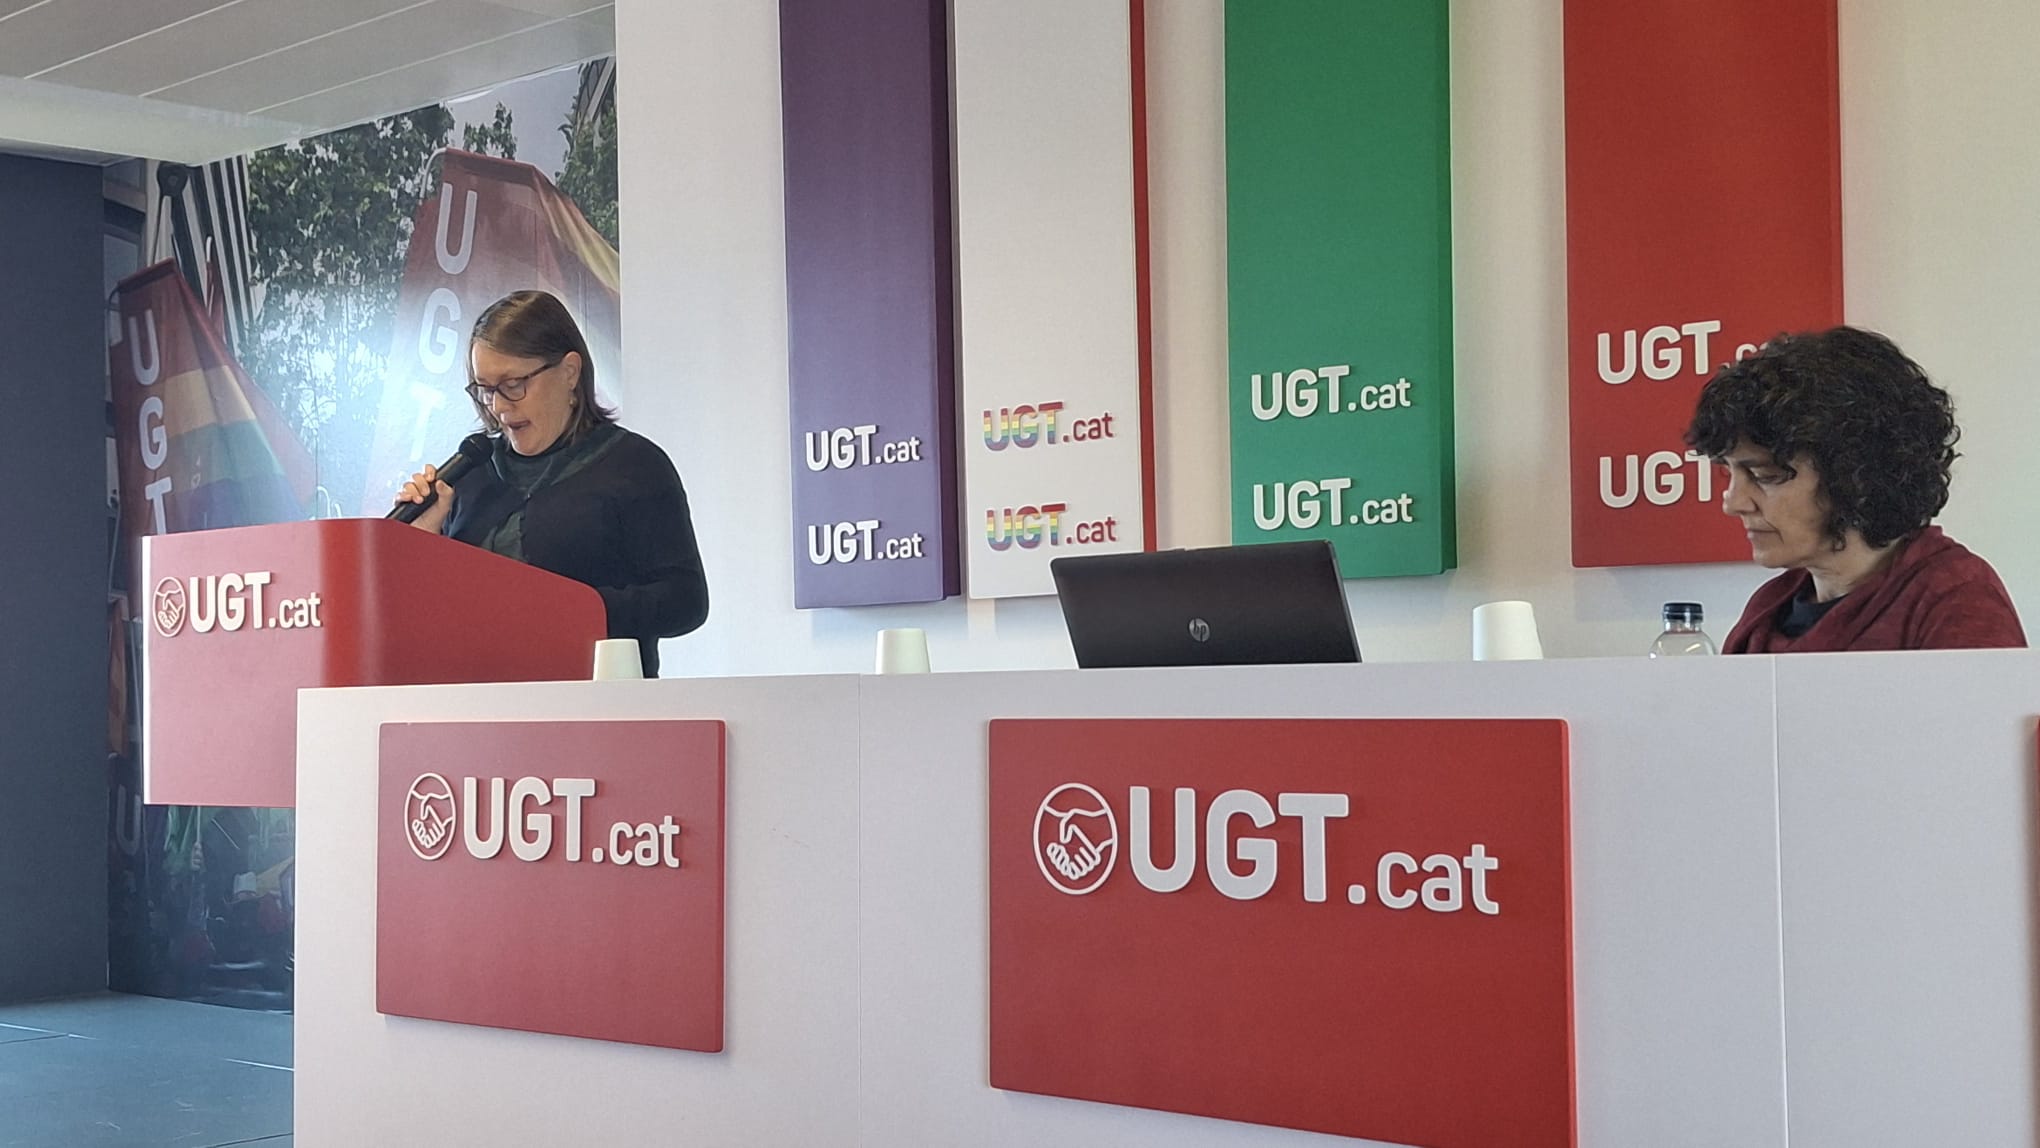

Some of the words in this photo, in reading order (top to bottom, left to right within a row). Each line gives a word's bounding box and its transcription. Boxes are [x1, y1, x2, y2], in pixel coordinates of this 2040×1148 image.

[1252, 365, 1411, 421] UGT.cat
[806, 425, 920, 471] UGT.cat
[984, 401, 1114, 451] UGT.cat
[986, 503, 1117, 551] UGT.cat
[1253, 478, 1413, 530] UGT.cat
[808, 520, 923, 564] UGT.cat
[190, 571, 321, 633] UGT.cat
[1189, 618, 1210, 642] hp
[463, 777, 680, 868] UGT.cat
[1129, 786, 1500, 915] UGT.cat
